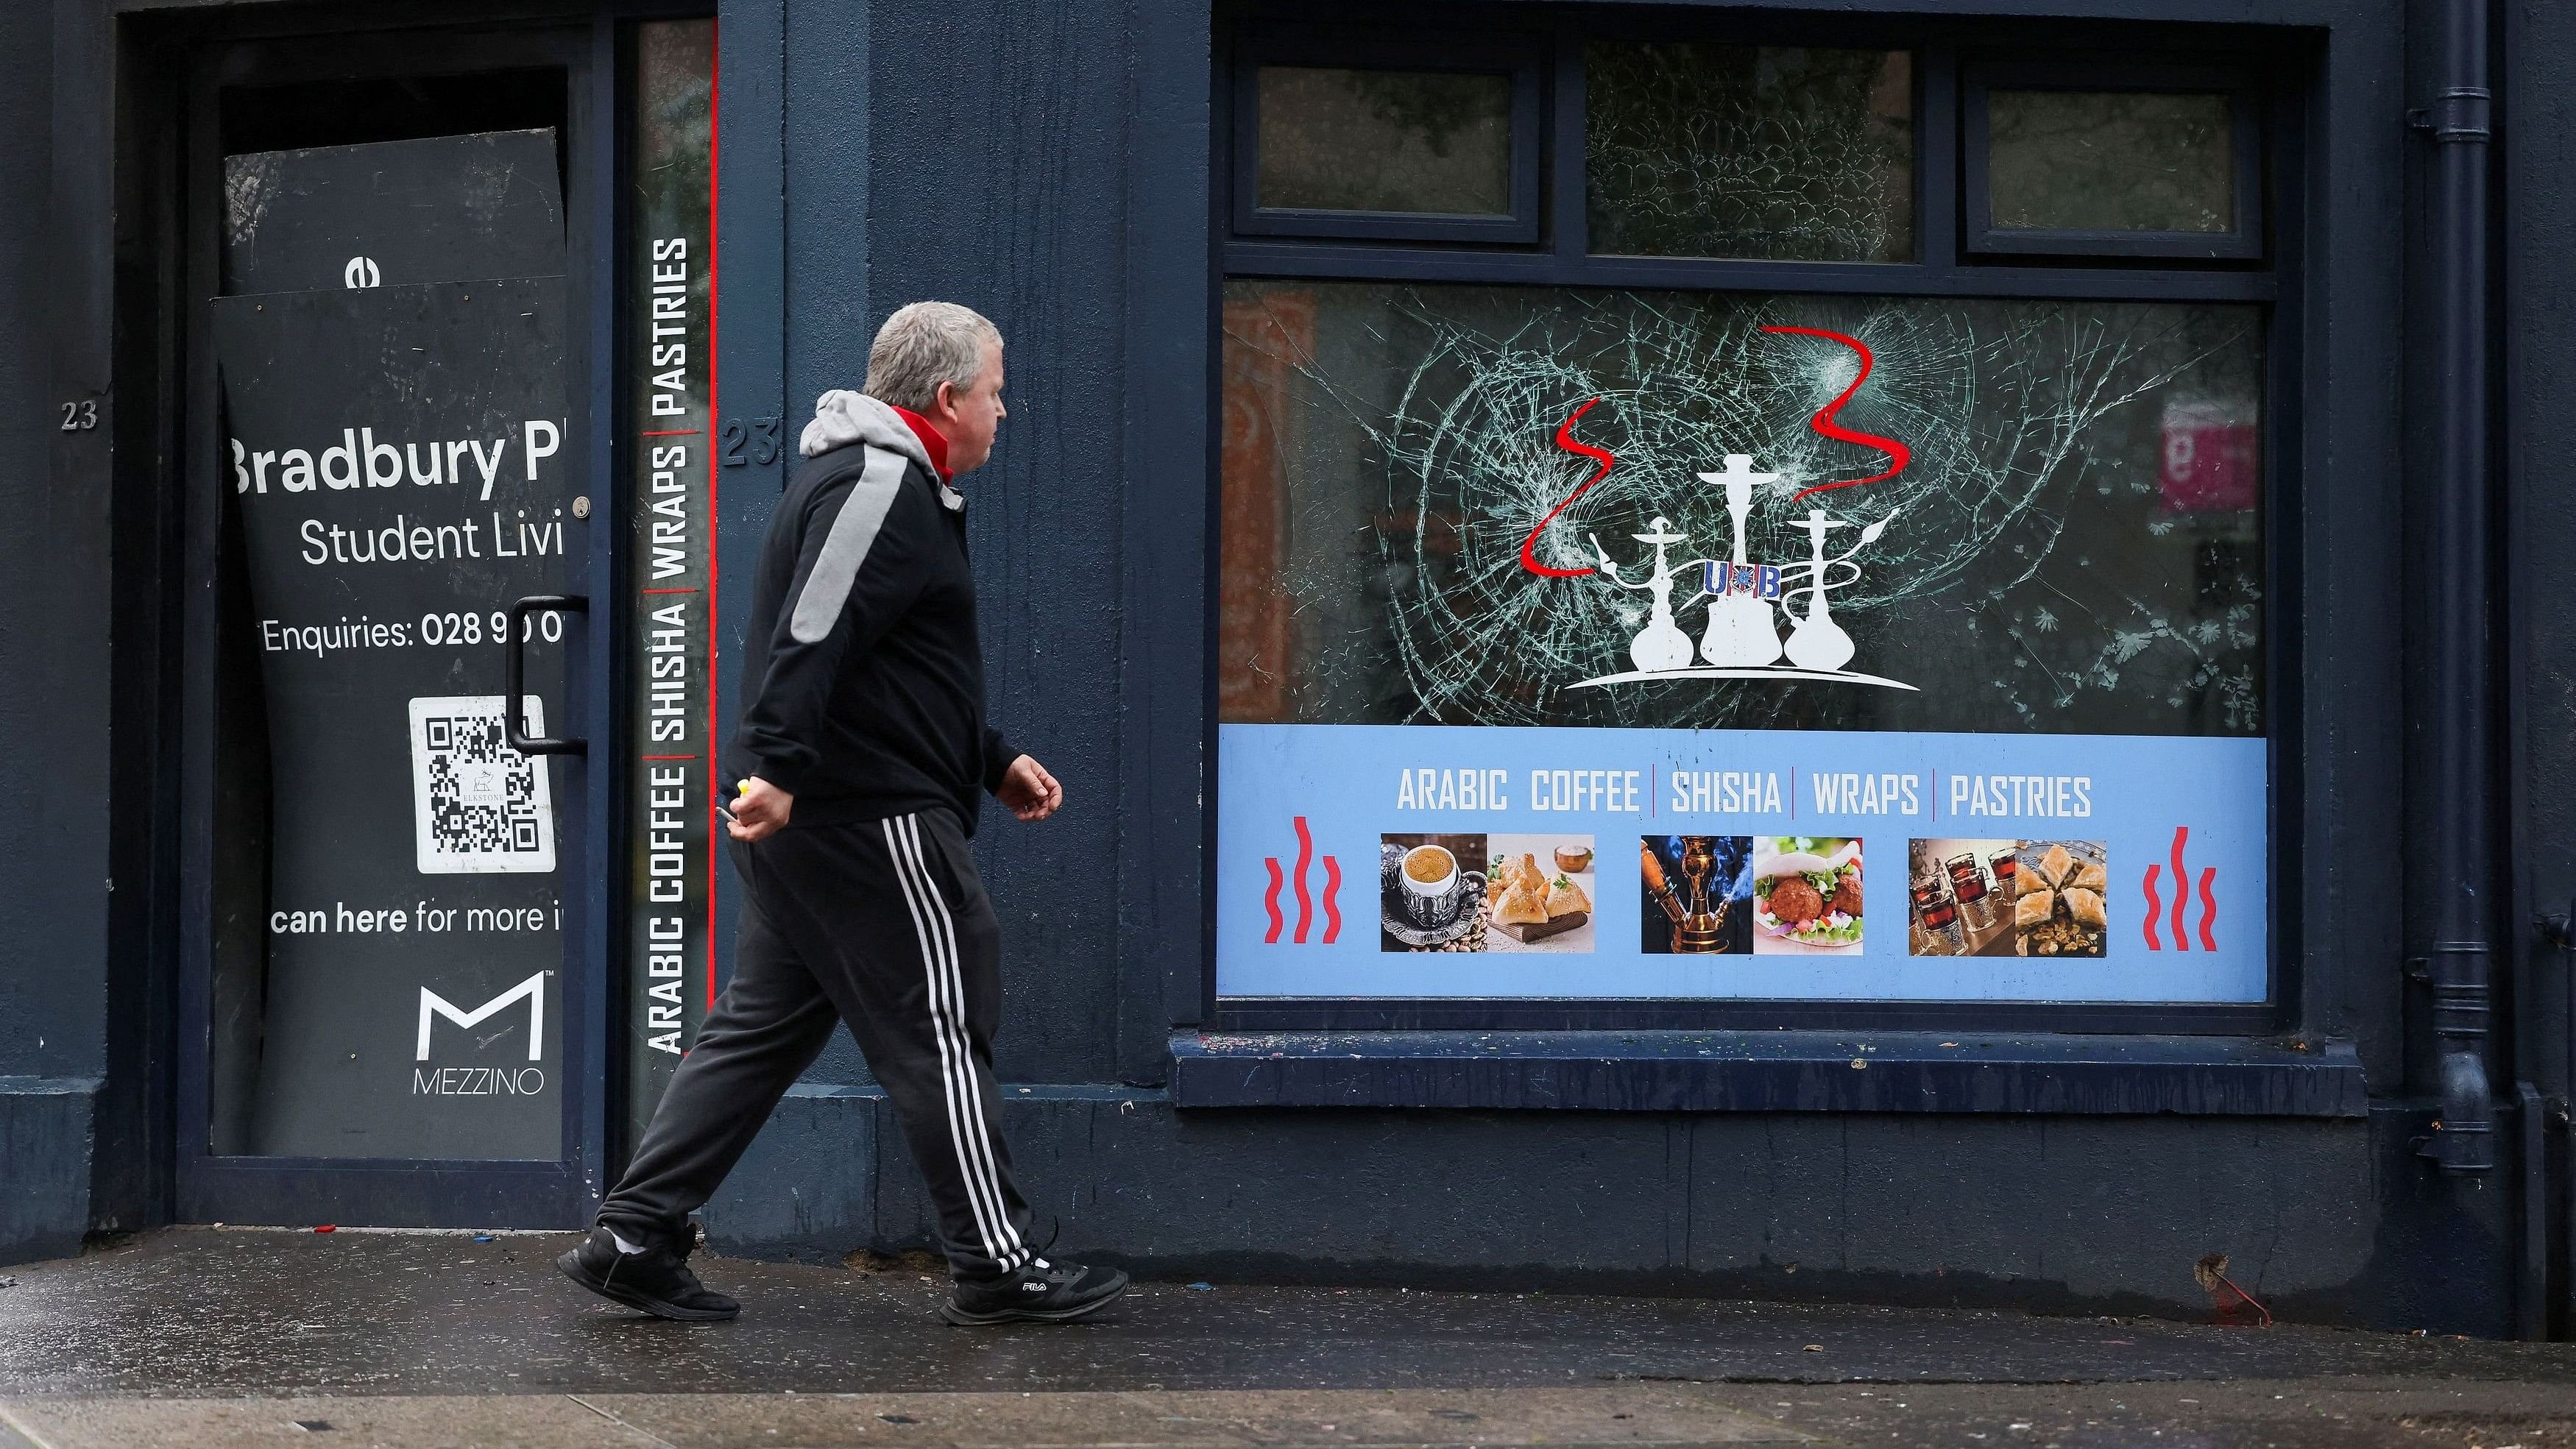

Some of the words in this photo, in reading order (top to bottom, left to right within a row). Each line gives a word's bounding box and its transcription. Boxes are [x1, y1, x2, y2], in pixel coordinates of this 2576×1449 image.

[651, 238, 687, 417] PASTRIES
[61, 400, 97, 431] 23
[723, 417, 778, 465] 23
[525, 417, 566, 481] P
[300, 514, 481, 565] Student
[493, 508, 563, 557] Livi
[651, 445, 687, 581] WRAPS
[263, 616, 414, 659] Enquiries:
[421, 612, 482, 645] 028
[651, 602, 686, 742] SHISHA
[1397, 768, 1507, 810] ARABIC
[1531, 770, 1640, 812] COFFEE
[1672, 771, 1782, 813] SHISHA
[1813, 773, 1919, 815] WRAPS
[1951, 775, 2091, 817] PASTRIES
[649, 766, 684, 902] COFFEE
[270, 910, 327, 934] can
[336, 901, 408, 933] here
[416, 900, 457, 932] for
[467, 908, 544, 932] more
[648, 917, 683, 1055] ARABIC
[413, 1067, 545, 1095] MEZZINO
[1022, 1283, 1047, 1291] FILA
